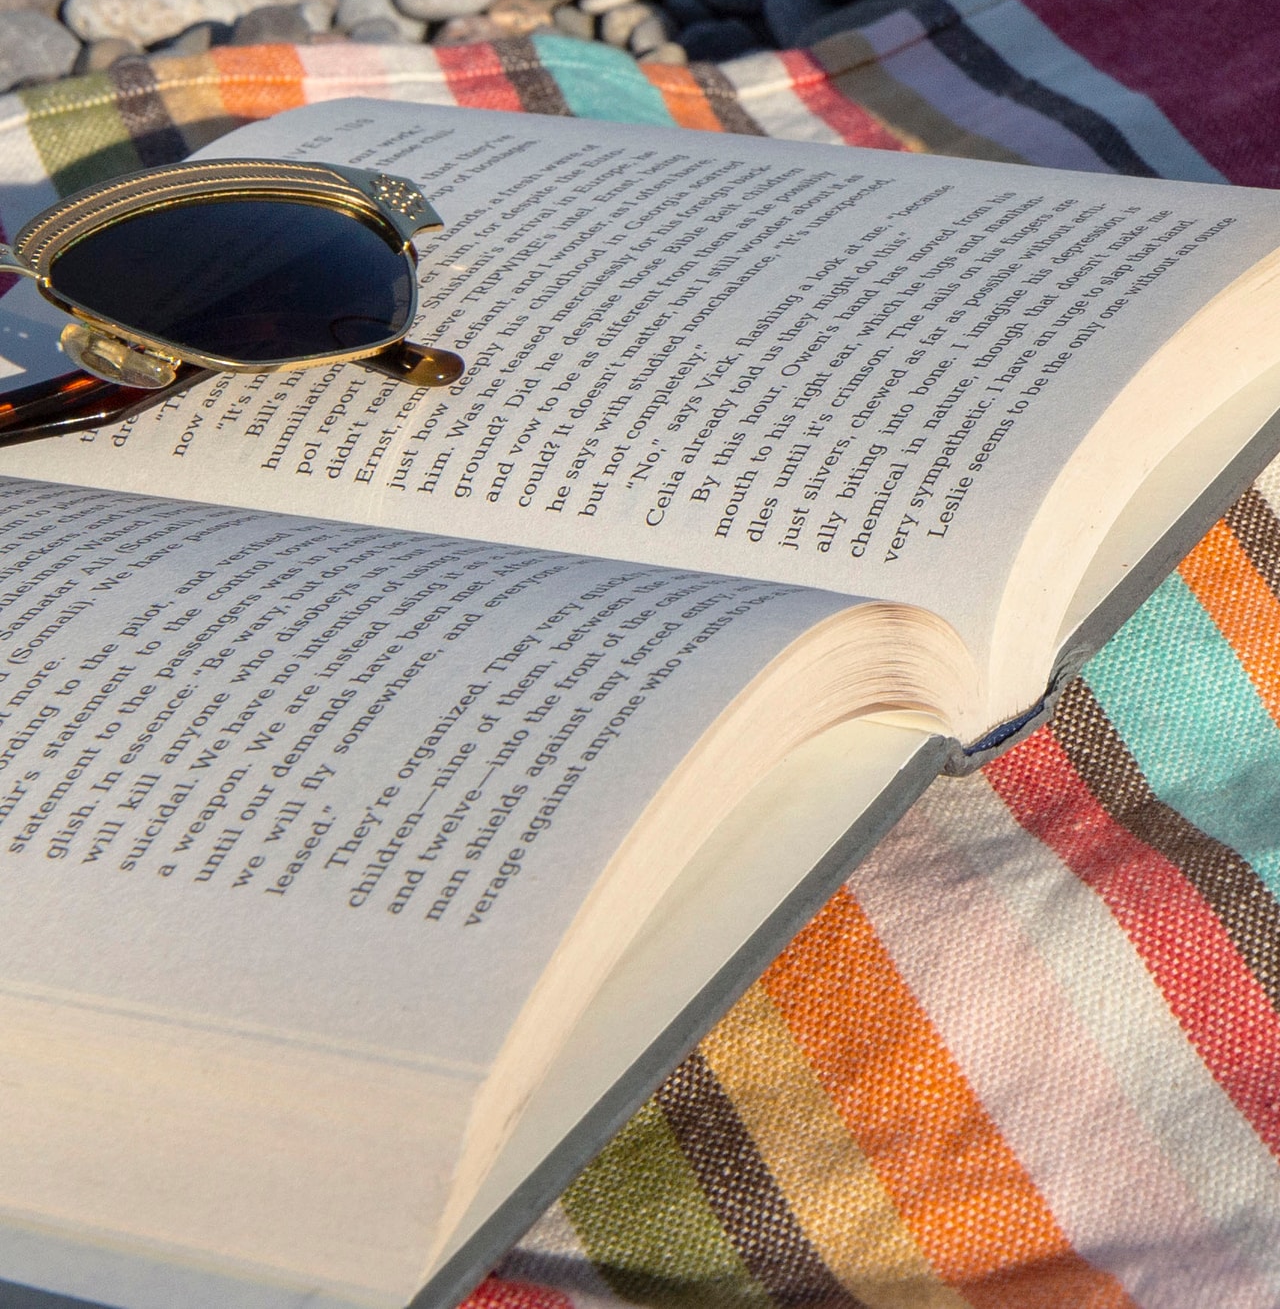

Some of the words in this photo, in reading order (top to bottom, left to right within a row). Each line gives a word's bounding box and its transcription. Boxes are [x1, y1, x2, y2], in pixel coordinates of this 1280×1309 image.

[260, 361, 346, 470] humiliation
[433, 241, 480, 267] him,
[472, 222, 501, 238] for
[500, 185, 558, 220] despite
[554, 168, 581, 183] the
[385, 448, 419, 491] just
[409, 402, 449, 442] how
[447, 341, 505, 396] deeply
[495, 314, 529, 337] his
[528, 248, 608, 310] childhood
[601, 233, 627, 246] in
[623, 191, 690, 230] Georgia
[453, 414, 509, 498] ground?
[502, 377, 541, 408] Did
[533, 351, 564, 372] he
[561, 293, 622, 346] despise
[617, 257, 666, 289] those
[660, 226, 708, 254] Bible
[702, 202, 742, 223] Belt
[741, 167, 805, 201] children
[517, 440, 561, 508] could?
[551, 422, 575, 437] It
[619, 310, 678, 359] matter,
[666, 285, 703, 306] but
[706, 255, 741, 277] still
[735, 215, 793, 253] wonder
[790, 190, 835, 215] about
[551, 207, 594, 230] intel.
[666, 395, 703, 432] says
[692, 352, 744, 390] Vick,
[734, 293, 804, 347] flashing
[804, 256, 848, 281] look
[843, 243, 864, 255] at
[858, 224, 893, 242] me,
[849, 462, 909, 558] chemical
[900, 436, 928, 455] in
[921, 375, 979, 430] nature,
[970, 321, 1029, 368] though
[1021, 293, 1060, 317] that
[1105, 225, 1149, 251] make
[1145, 209, 1173, 223] me
[925, 476, 974, 538] Leslie
[967, 418, 1015, 472] seems
[1005, 399, 1029, 414] to
[1018, 377, 1049, 396] be
[1040, 351, 1073, 374] the
[1067, 320, 1106, 349] only
[1098, 297, 1129, 319] one
[1122, 256, 1180, 296] without
[1174, 243, 1199, 256] an
[1193, 217, 1237, 243] ounce
[5, 597, 97, 665] (Somali).
[89, 570, 133, 591] We
[126, 542, 184, 568] have
[7, 746, 102, 853] statement
[94, 721, 122, 740] to
[116, 684, 157, 714] the
[153, 593, 262, 679] passengers
[258, 566, 303, 590] was
[297, 554, 328, 565] in
[80, 820, 125, 864] will
[116, 773, 161, 810] kill
[159, 691, 230, 764] anyone
[228, 648, 274, 683] who
[274, 582, 360, 642] disobeys
[359, 564, 396, 578] us,
[388, 548, 432, 561] but
[157, 863, 177, 877] a
[172, 763, 252, 853] weapon.
[243, 721, 286, 752] We
[283, 684, 320, 714] are
[313, 620, 391, 679] instead
[387, 581, 449, 616] using
[231, 855, 265, 888] we
[262, 800, 307, 843] will
[299, 763, 336, 791] fly
[332, 648, 444, 754] somewhere,
[442, 612, 484, 641] and
[483, 565, 569, 608] everyone
[476, 713, 501, 733] of
[495, 659, 558, 706] them,
[547, 596, 635, 651] between
[631, 580, 669, 593] the
[463, 847, 526, 926] verage
[519, 765, 587, 843] against
[579, 694, 646, 762] anyone
[638, 657, 682, 691] who
[675, 615, 733, 655] wants
